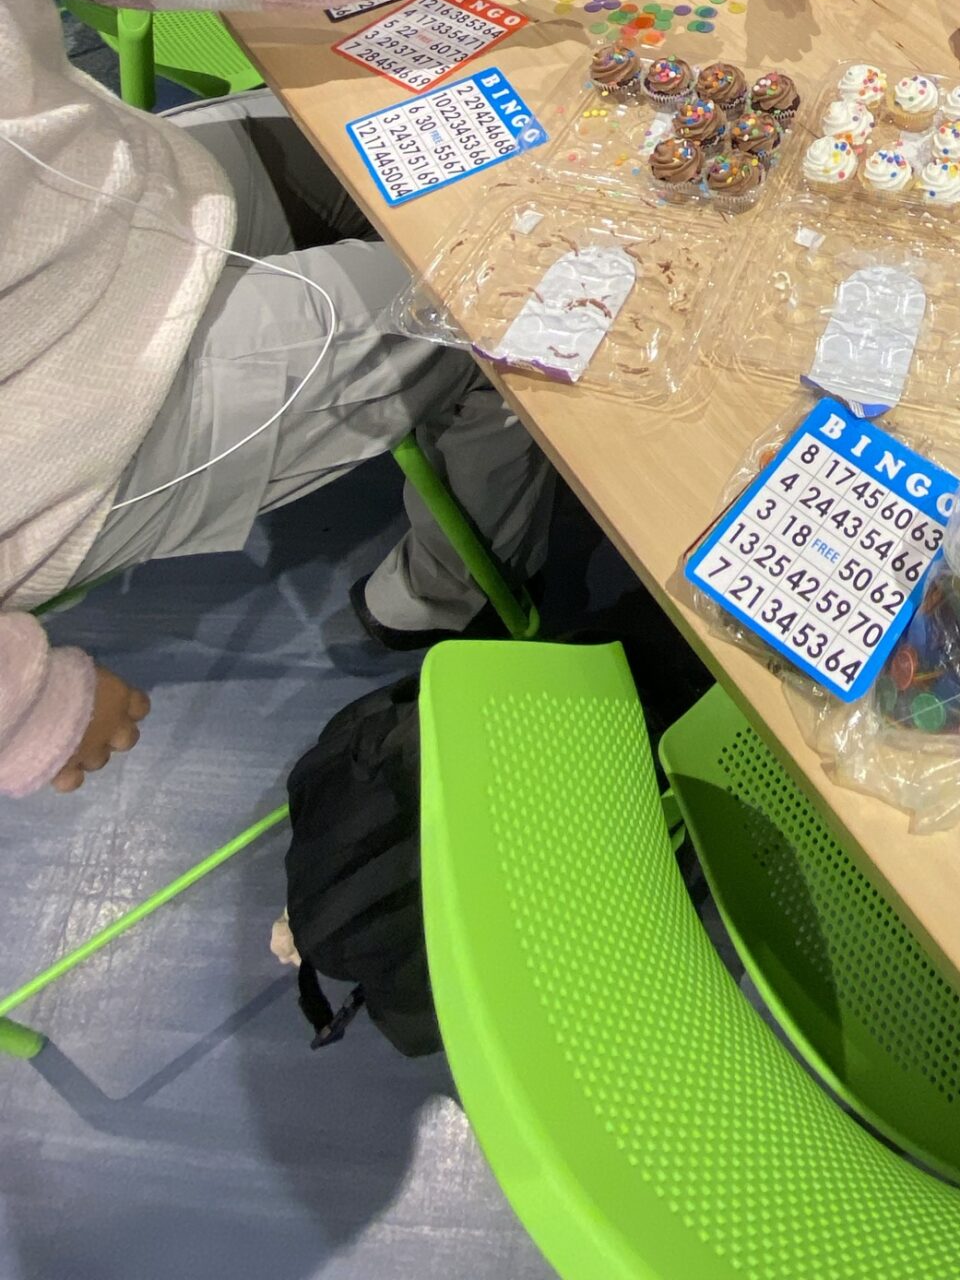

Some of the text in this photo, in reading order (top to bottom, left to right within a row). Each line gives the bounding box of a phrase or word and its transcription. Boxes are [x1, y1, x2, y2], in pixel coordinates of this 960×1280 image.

[364, 30, 450, 74] 3 29 37 47 75
[383, 19, 399, 28] 5
[395, 25, 418, 39] 22
[429, 42, 451, 54] 60
[446, 48, 468, 62] 73
[403, 9, 485, 50] 4 17 33 54 71
[434, 3, 453, 16] 16
[448, 10, 470, 23] 38
[465, 18, 487, 31] 53
[482, 26, 504, 39] 64
[344, 41, 431, 87] 7 28 45 46 69
[408, 106, 466, 174] 6 30 FREE 55 67
[432, 92, 490, 165] 10 22 34 53 66
[456, 85, 515, 154] 2 29 42 46 68
[481, 73, 540, 142] BINGO
[356, 120, 413, 197] 12 17 44 50 64
[383, 113, 439, 185] 3 24 37 51 69
[800, 444, 944, 551] 8 17 45 60 63
[819, 413, 960, 516] BINGO
[756, 498, 905, 616] 3 18 FREE 50 62
[779, 473, 923, 582] 4 24 43 54 66
[708, 556, 862, 684] 7 21 34 53 64
[729, 522, 883, 648] 13 25 42 59 70
